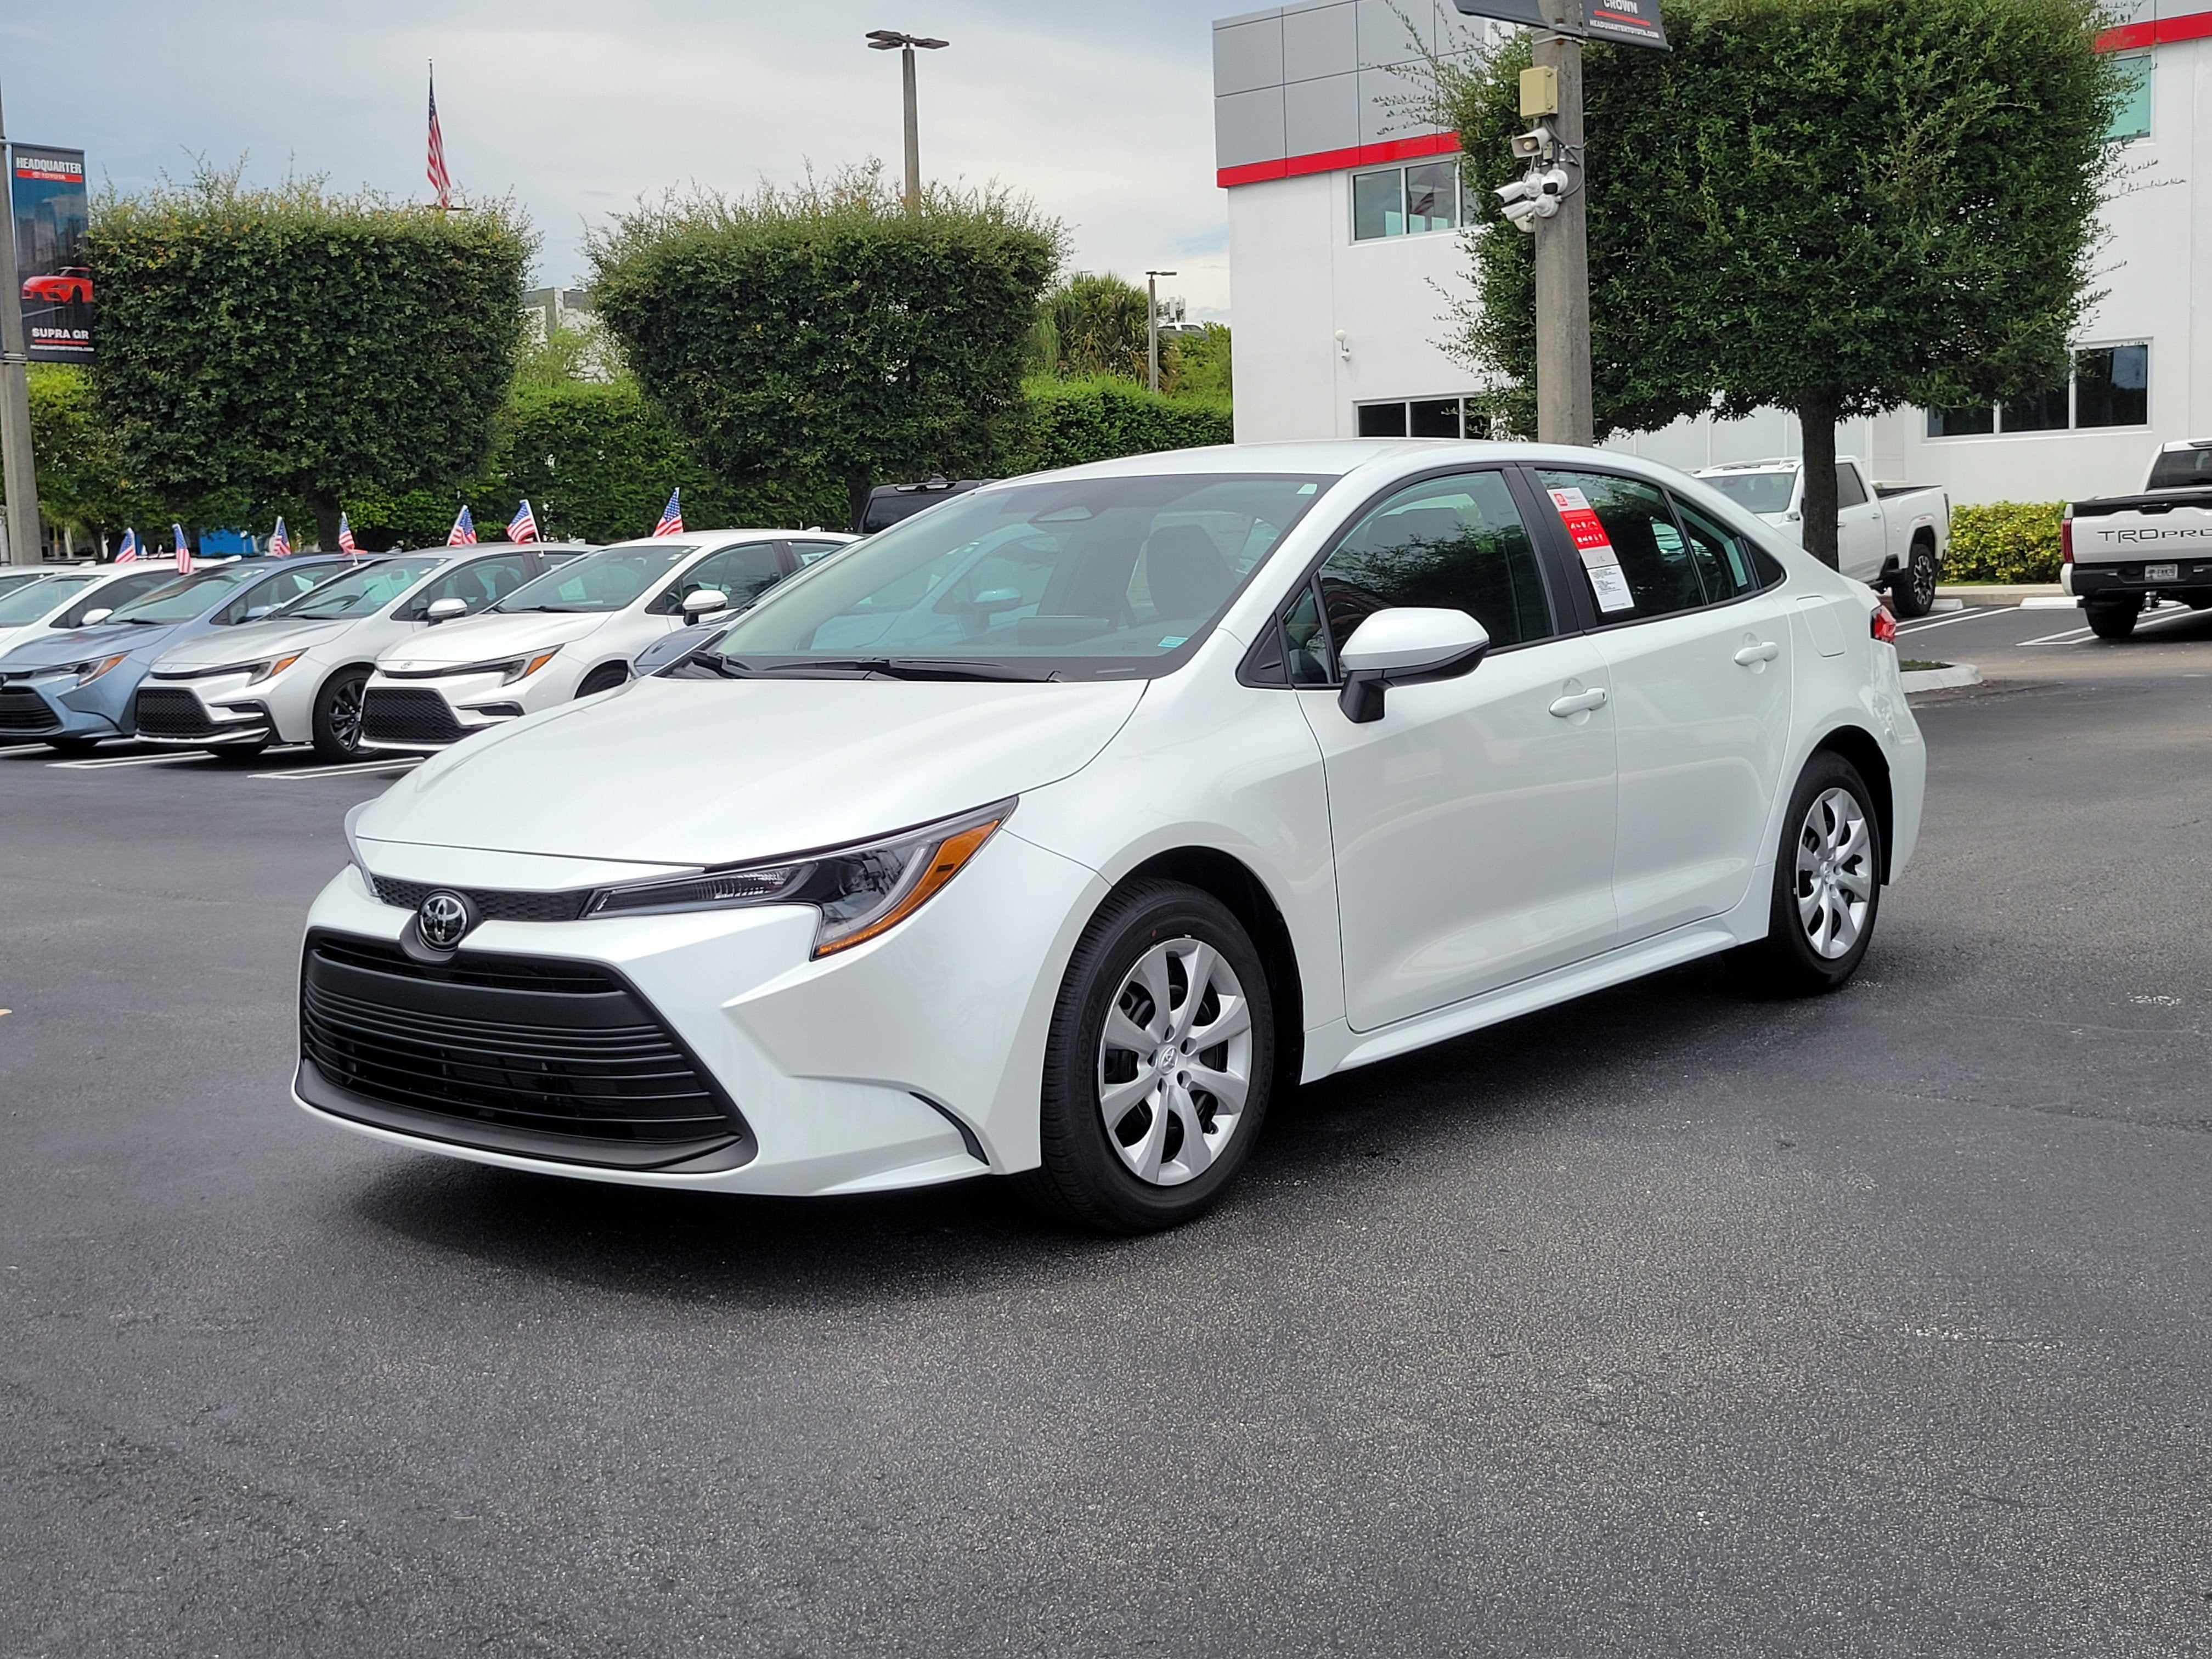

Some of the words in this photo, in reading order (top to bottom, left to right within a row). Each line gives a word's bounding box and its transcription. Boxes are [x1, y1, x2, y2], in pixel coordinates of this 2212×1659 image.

[1604, 0, 1638, 14] CROWN
[16, 157, 82, 174] HEADQUARTER
[32, 328, 71, 338] SUPRA
[72, 330, 89, 340] GR
